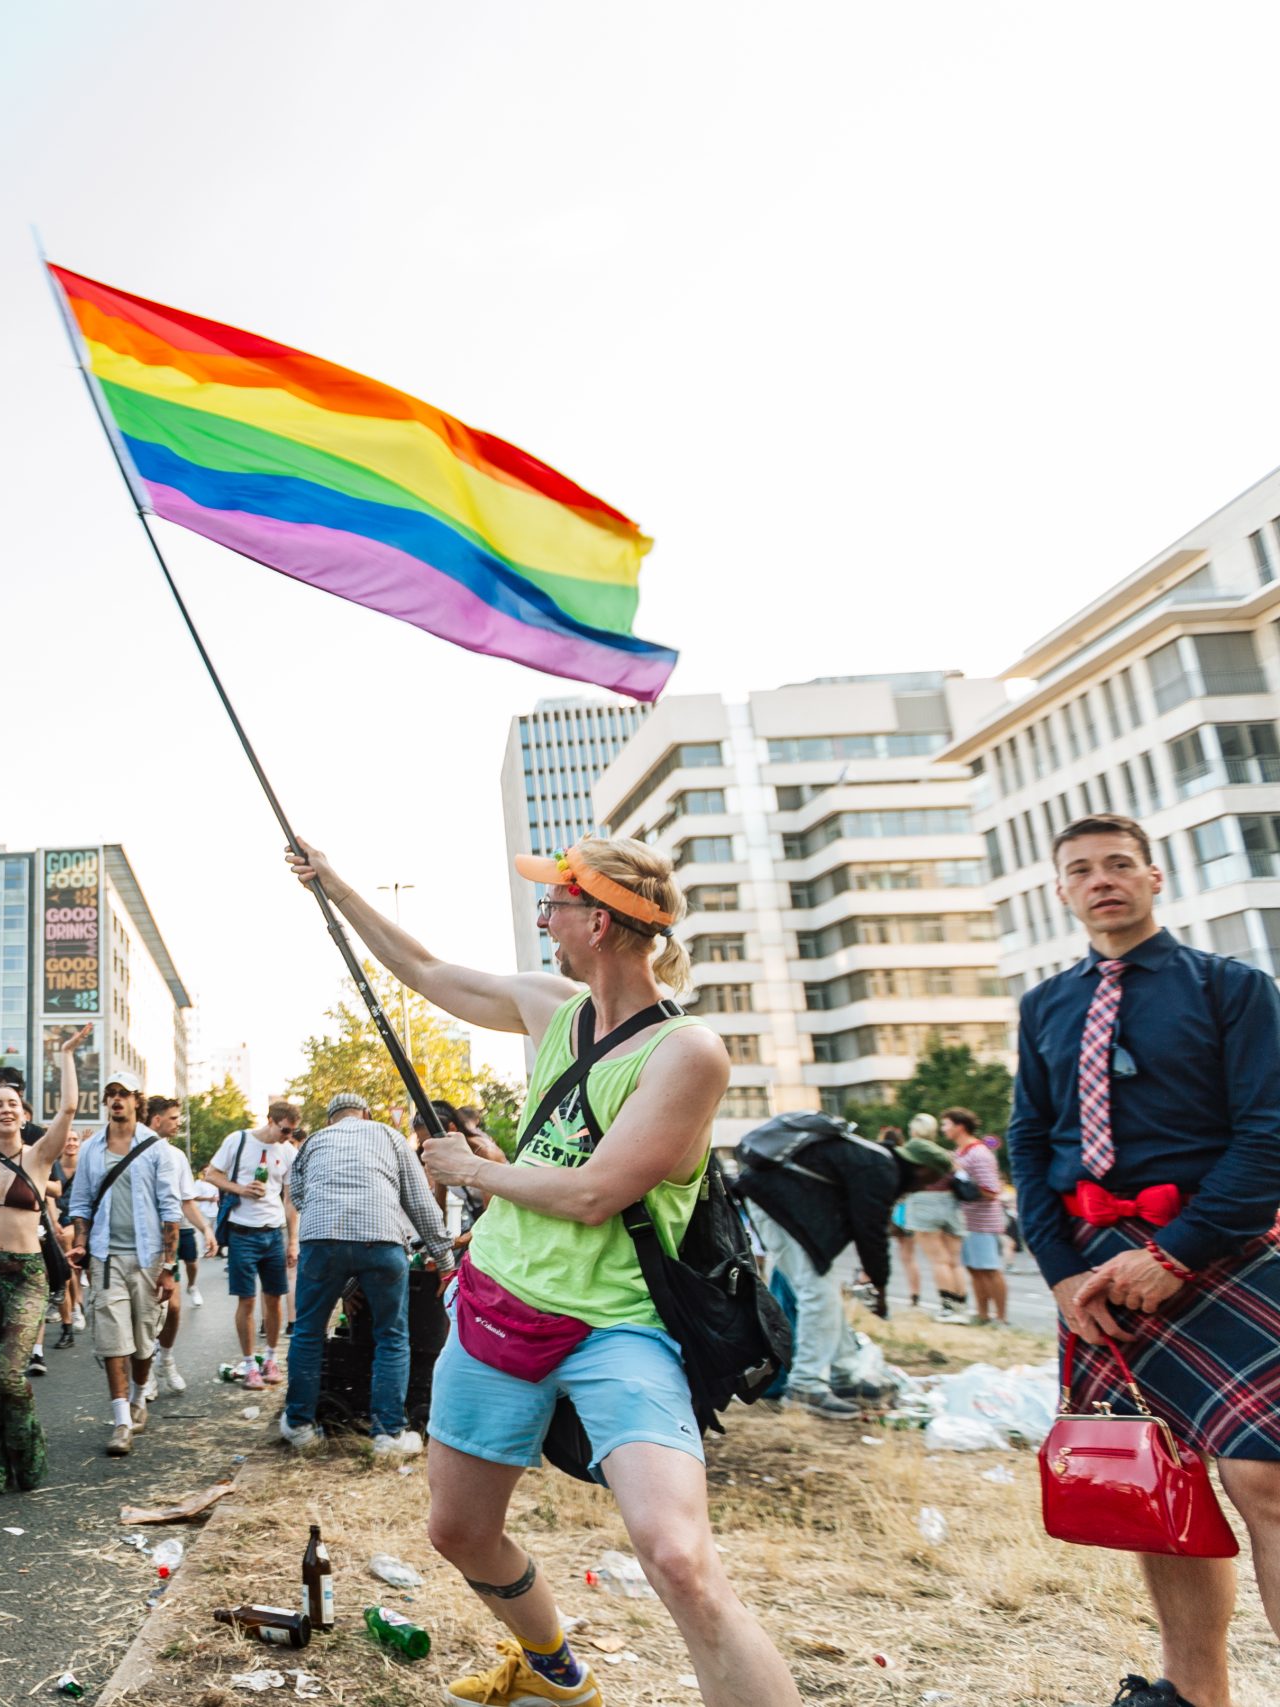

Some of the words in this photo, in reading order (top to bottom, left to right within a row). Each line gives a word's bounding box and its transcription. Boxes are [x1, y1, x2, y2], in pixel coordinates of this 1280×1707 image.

[46, 852, 97, 873] GOOD
[46, 873, 97, 889] FOOD
[46, 907, 97, 922] GOOD
[46, 922, 97, 940] DRINKS
[46, 957, 97, 972] GOOD
[46, 972, 97, 990] TIMES
